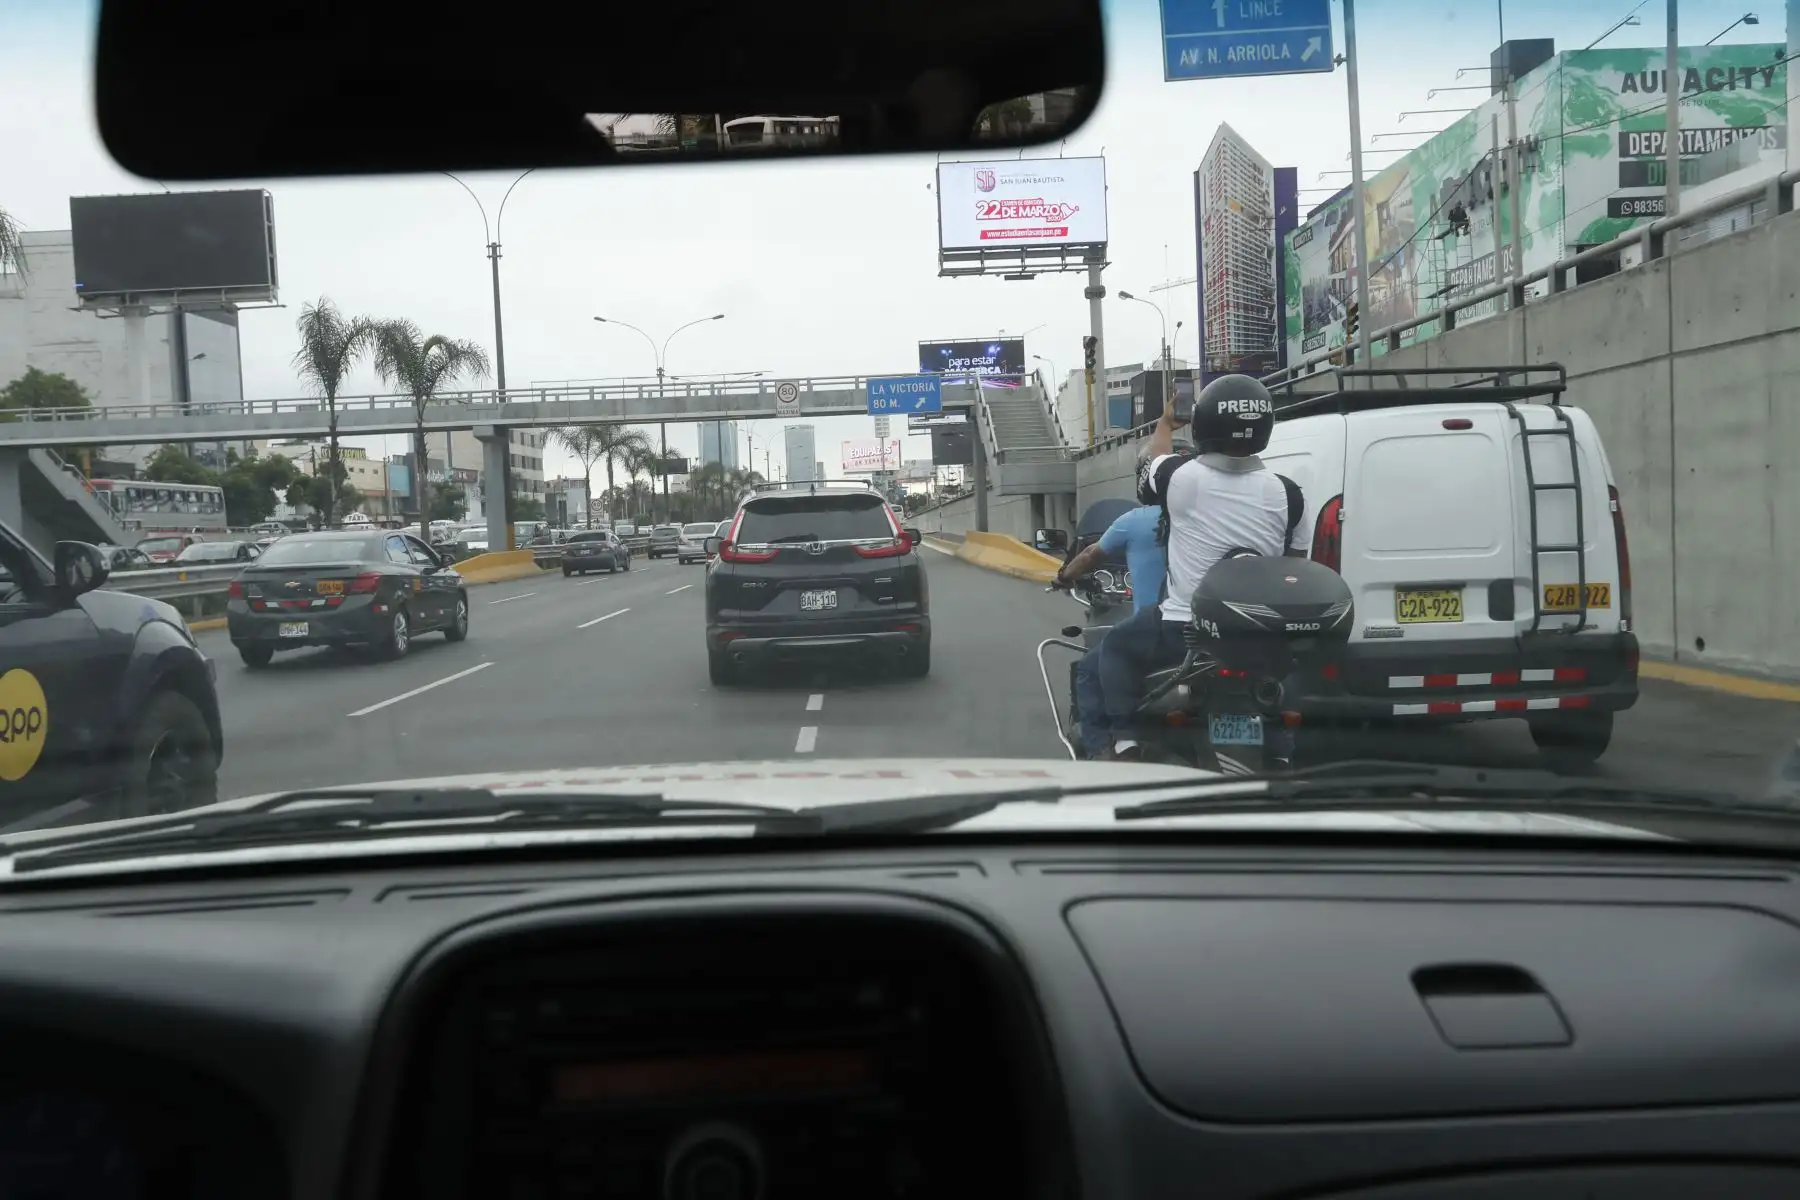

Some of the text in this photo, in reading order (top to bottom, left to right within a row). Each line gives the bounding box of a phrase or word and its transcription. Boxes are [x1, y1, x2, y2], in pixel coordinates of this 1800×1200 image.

[1240, 1, 1283, 18] LINCE
[1180, 43, 1291, 66] AV. N. ARRIOLA
[1033, 176, 1065, 184] BAUTISTA
[976, 200, 1061, 220] 22 DE MARZO
[949, 356, 996, 368] para estar
[782, 387, 794, 396] 80
[872, 381, 936, 395] LA VICTORIA
[873, 398, 901, 408] 80 M.
[1217, 399, 1273, 414] PRENSA
[1398, 597, 1461, 618] C2A-922
[1285, 623, 1321, 631] SHAD
